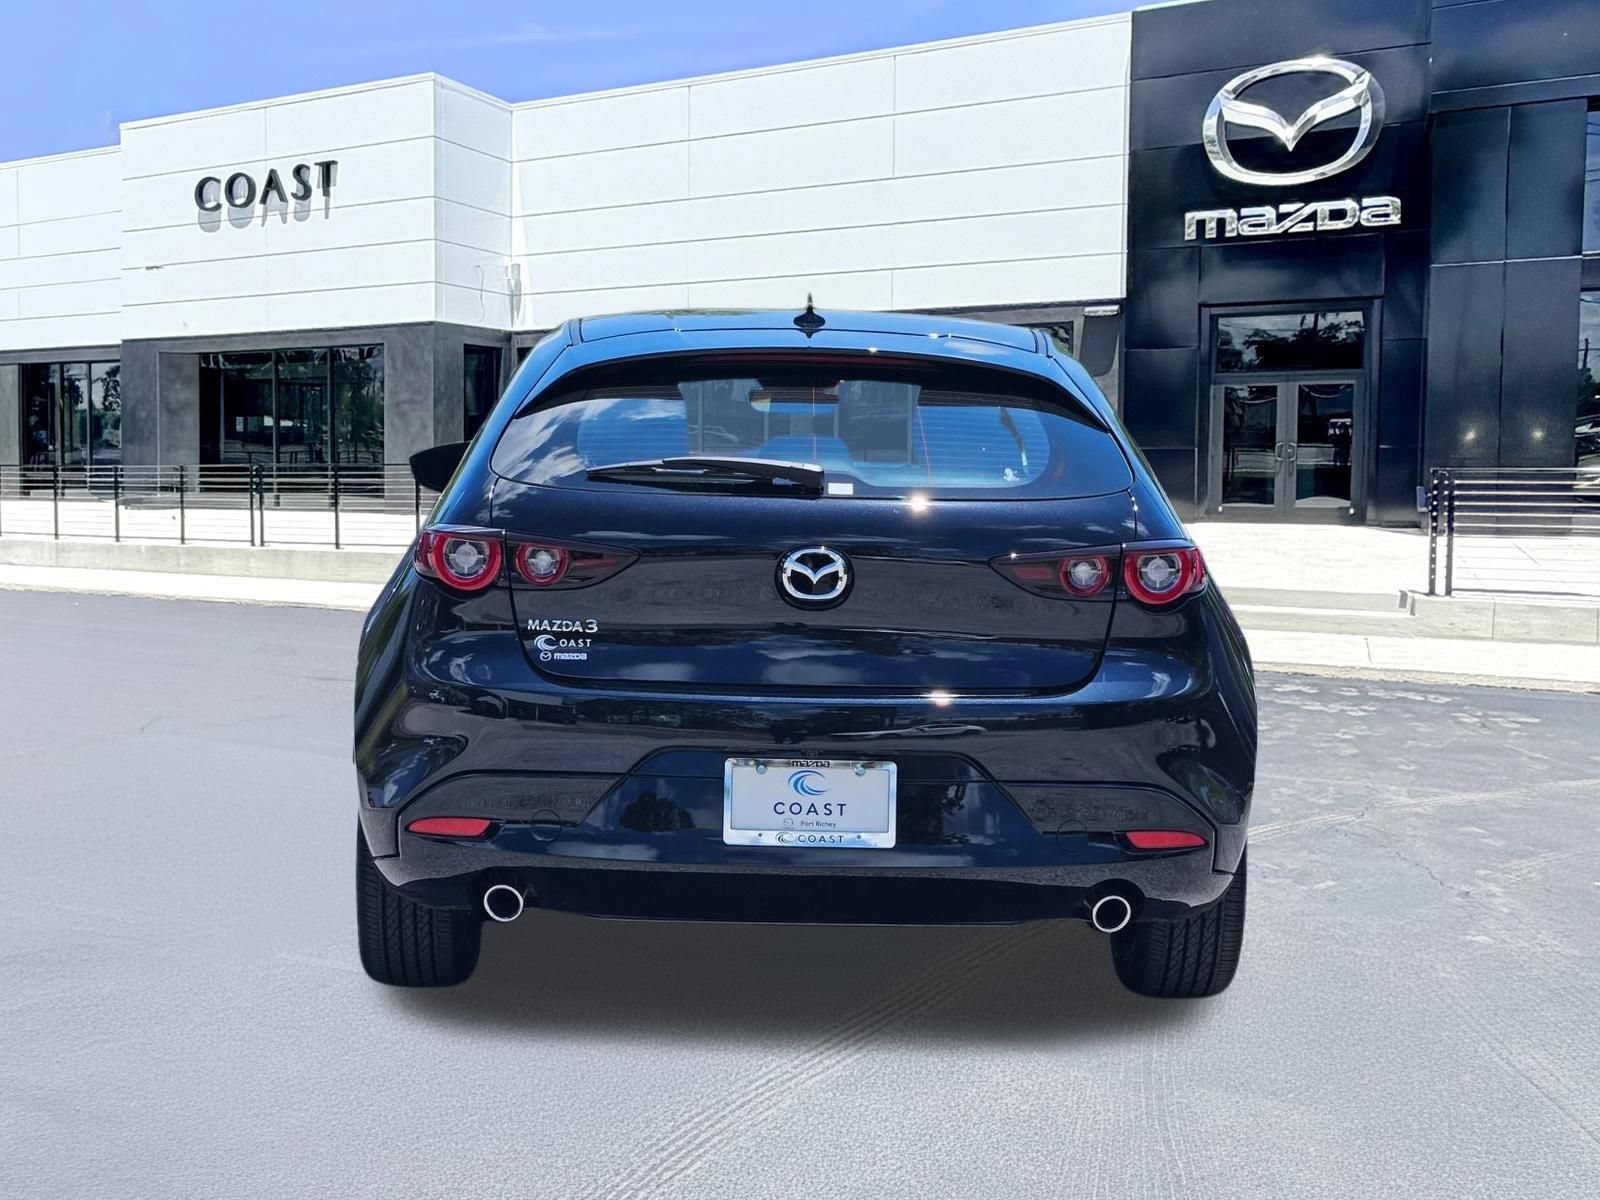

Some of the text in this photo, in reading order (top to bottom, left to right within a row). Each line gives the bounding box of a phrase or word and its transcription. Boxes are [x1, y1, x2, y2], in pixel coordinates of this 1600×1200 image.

[194, 160, 338, 212] COAST
[1184, 196, 1402, 241] mazda
[553, 652, 588, 661] mazda
[791, 760, 830, 769] mazda
[773, 801, 847, 817] COAST
[800, 820, 837, 829] Port Richey
[797, 834, 844, 844] COAST
